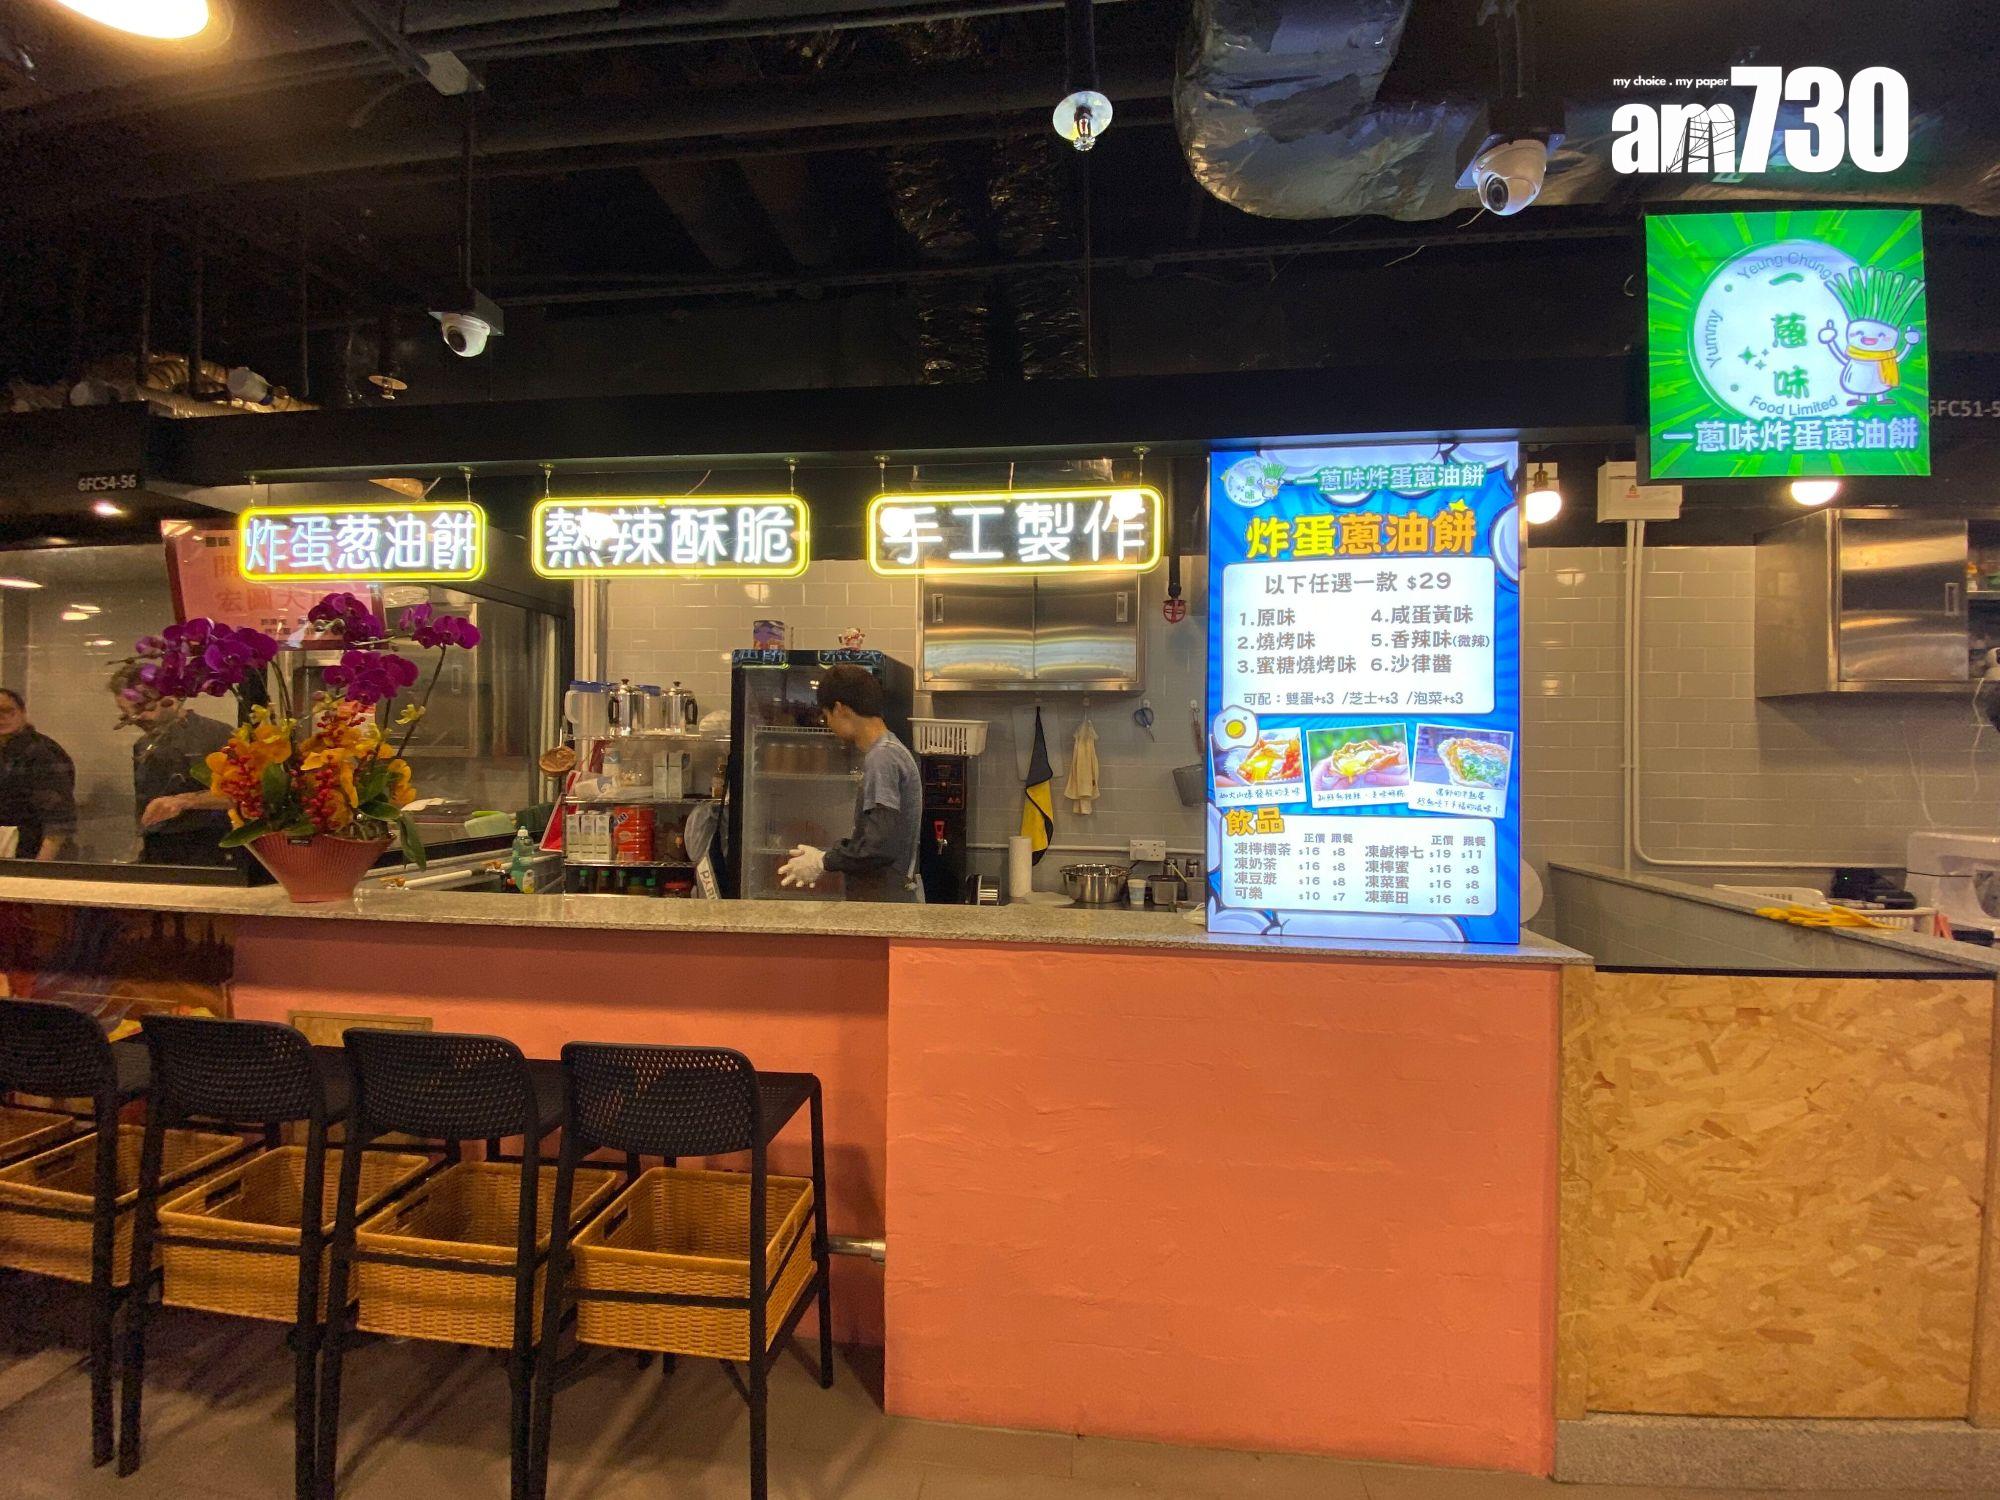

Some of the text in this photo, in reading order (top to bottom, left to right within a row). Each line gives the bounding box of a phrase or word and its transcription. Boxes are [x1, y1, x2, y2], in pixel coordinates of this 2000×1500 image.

[1737, 251, 1833, 281] Yeung Chung
[1704, 309, 1723, 368] Yummy
[1750, 395, 1838, 416] Food Limited
[1662, 418, 1919, 453] 一蔥味炸蛋蔥油餅
[78, 474, 137, 492] 6FC54-56
[1297, 464, 1485, 490] 一蔥味炸蛋蔥油餅
[545, 504, 795, 567] 熱辣酥脆
[882, 500, 1146, 564] 手工製作
[1246, 510, 1477, 558] 炸蛋蔥油餅
[1265, 571, 1452, 595] 以下任選一款 $29
[1239, 608, 1296, 627] 1.原味
[1370, 604, 1474, 624] 4.咸蛋黃味
[1237, 631, 1316, 651] 2.燒烤味
[1237, 655, 1357, 675] 3.蜜糖燒烤味
[1370, 654, 1452, 673] 6.沙律醬
[1225, 806, 1285, 837] 飲品
[1303, 832, 1353, 844] 正價 跟餐
[1430, 835, 1486, 847] 正價 跟餐
[1234, 842, 1346, 857] 凍檸檬茶 $16 $8
[1365, 844, 1482, 859] 凍鹹檸七 $19 $11
[1234, 856, 1346, 872] 凍奶茶 $16 $8
[1365, 859, 1480, 875] 凍檸蜜 $16 $8
[1234, 871, 1346, 887] 凍豆漿 $16 $8
[1365, 874, 1480, 890] 凍菜蜜 $16 $8
[1234, 886, 1346, 902] 可樂 $10 $7
[1365, 889, 1480, 905] 凍華田 $16 $8
